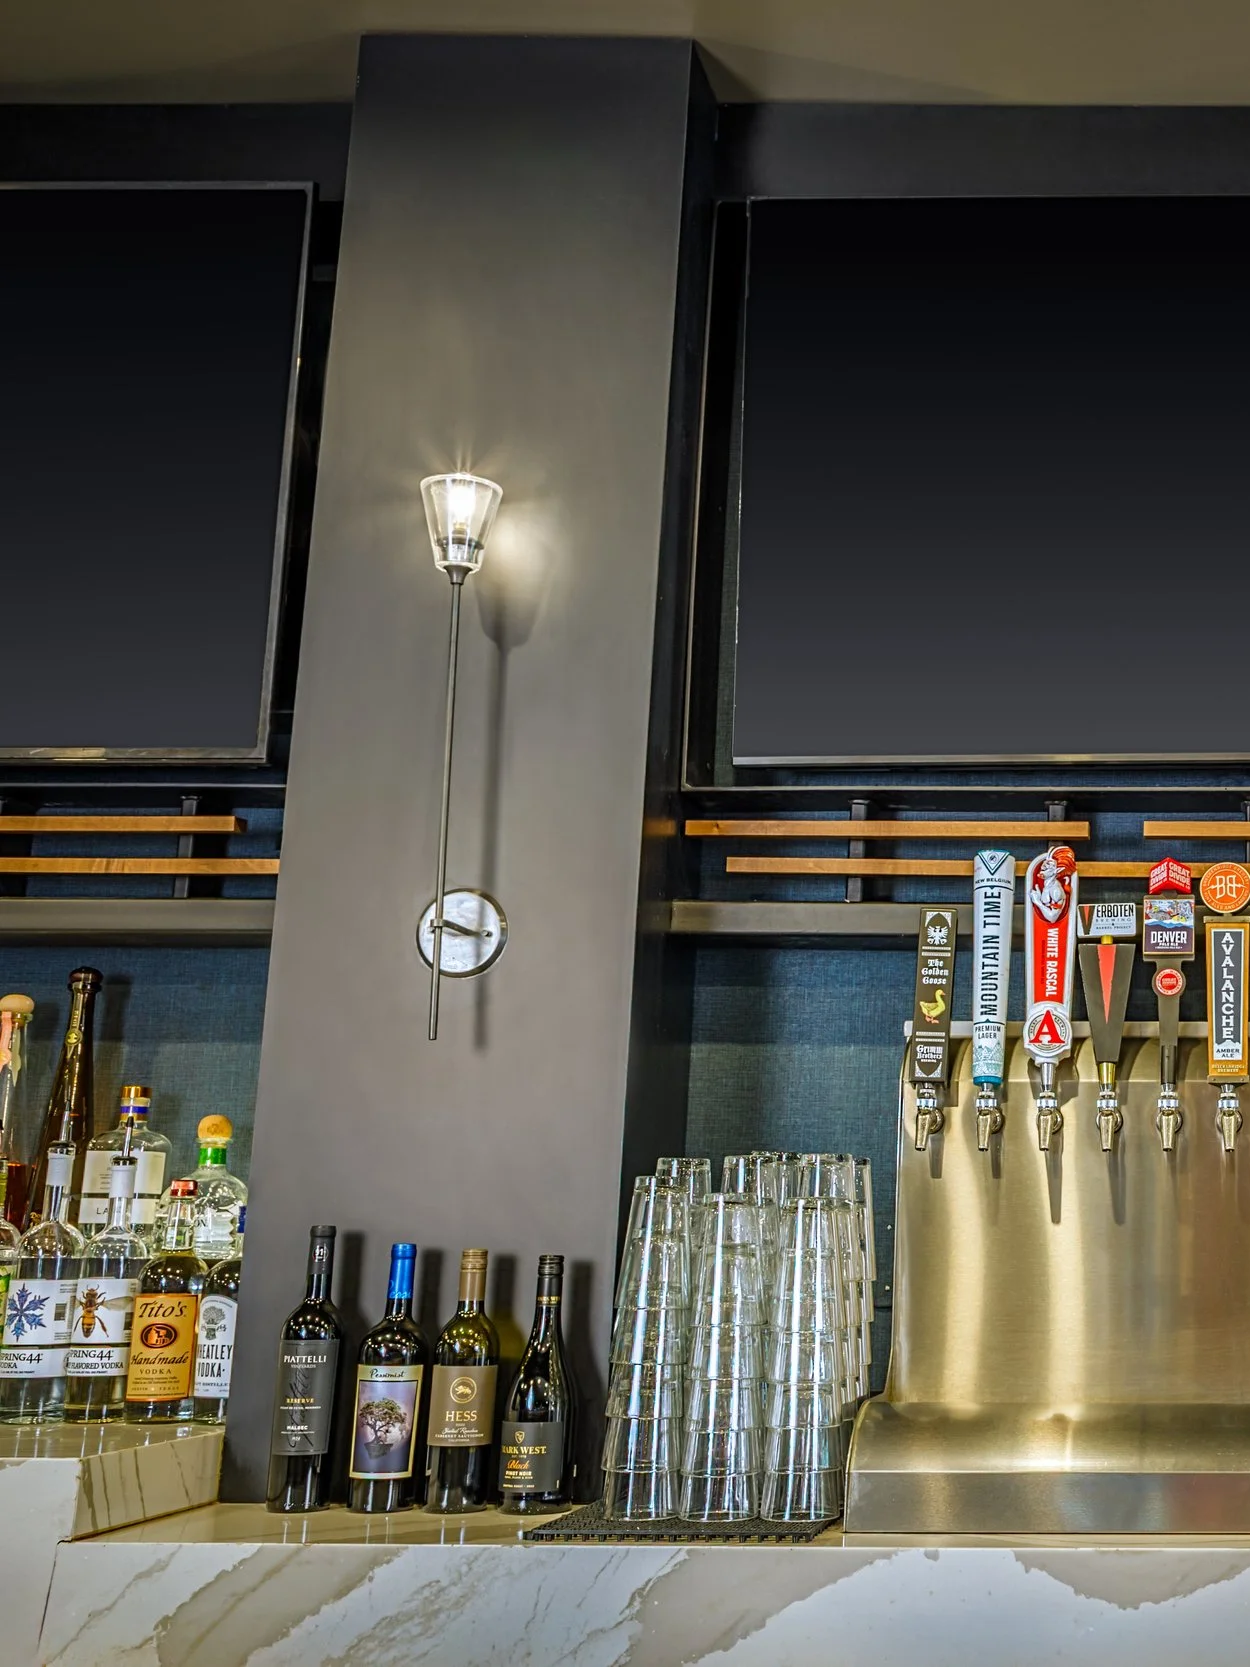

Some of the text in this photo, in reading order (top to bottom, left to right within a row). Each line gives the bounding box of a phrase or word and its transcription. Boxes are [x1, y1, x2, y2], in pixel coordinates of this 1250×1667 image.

[1151, 861, 1168, 879] GREAT
[1169, 861, 1190, 878] GREAT
[1169, 870, 1190, 886] DIVIDE
[1150, 930, 1187, 944] DENVER
[980, 892, 1001, 1016] MOUNTAIN TIME
[928, 959, 944, 967] The
[1046, 928, 1059, 997] WHITE RASCAL
[921, 967, 949, 976] Golden
[922, 977, 946, 985] Goose
[1221, 932, 1235, 1039] AVALANCHE
[1029, 1010, 1065, 1043] A
[916, 1044, 943, 1054] Grimm
[138, 1300, 187, 1318] Tito's
[0, 1353, 43, 1364] PRING44
[70, 1350, 114, 1360] PRING44
[131, 1351, 189, 1365] Handmade
[198, 1344, 233, 1360] HEATLEY
[446, 1410, 477, 1421] HESS
